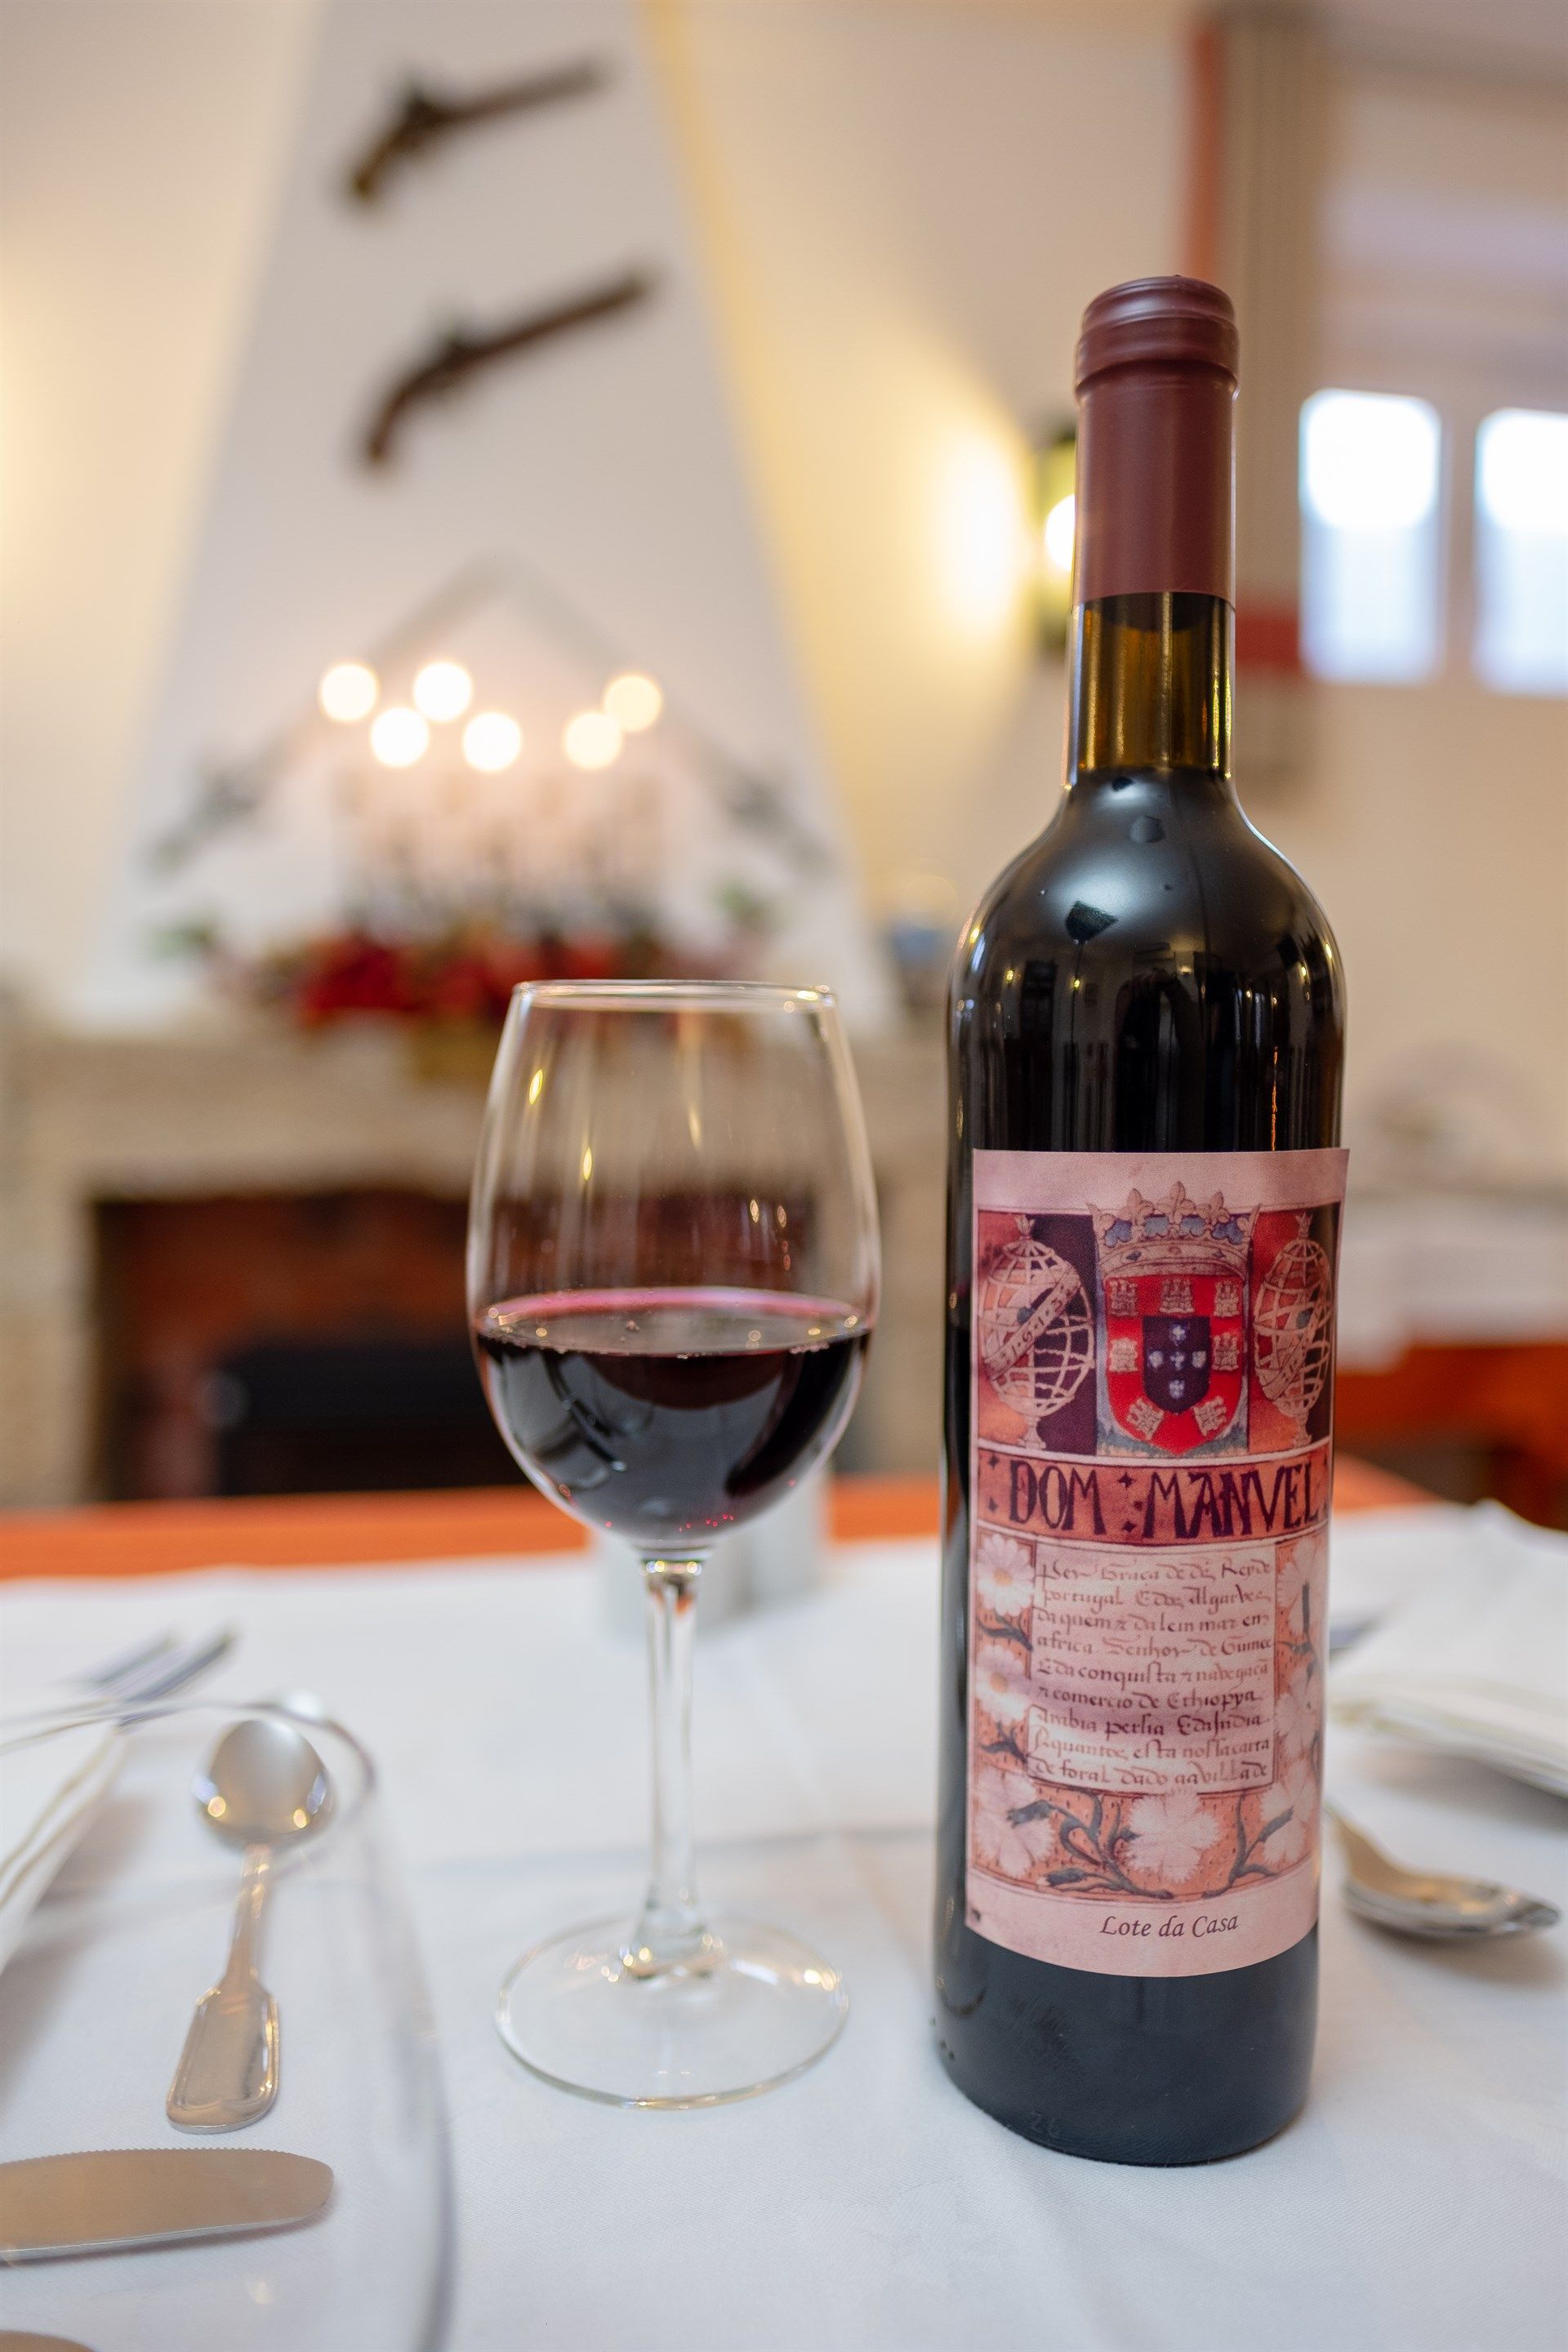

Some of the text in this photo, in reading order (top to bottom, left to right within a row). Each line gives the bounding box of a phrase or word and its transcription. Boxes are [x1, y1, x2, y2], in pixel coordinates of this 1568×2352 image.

[1009, 1459, 1107, 1535] DOM
[1099, 1914, 1239, 1938] Lote da Casa
